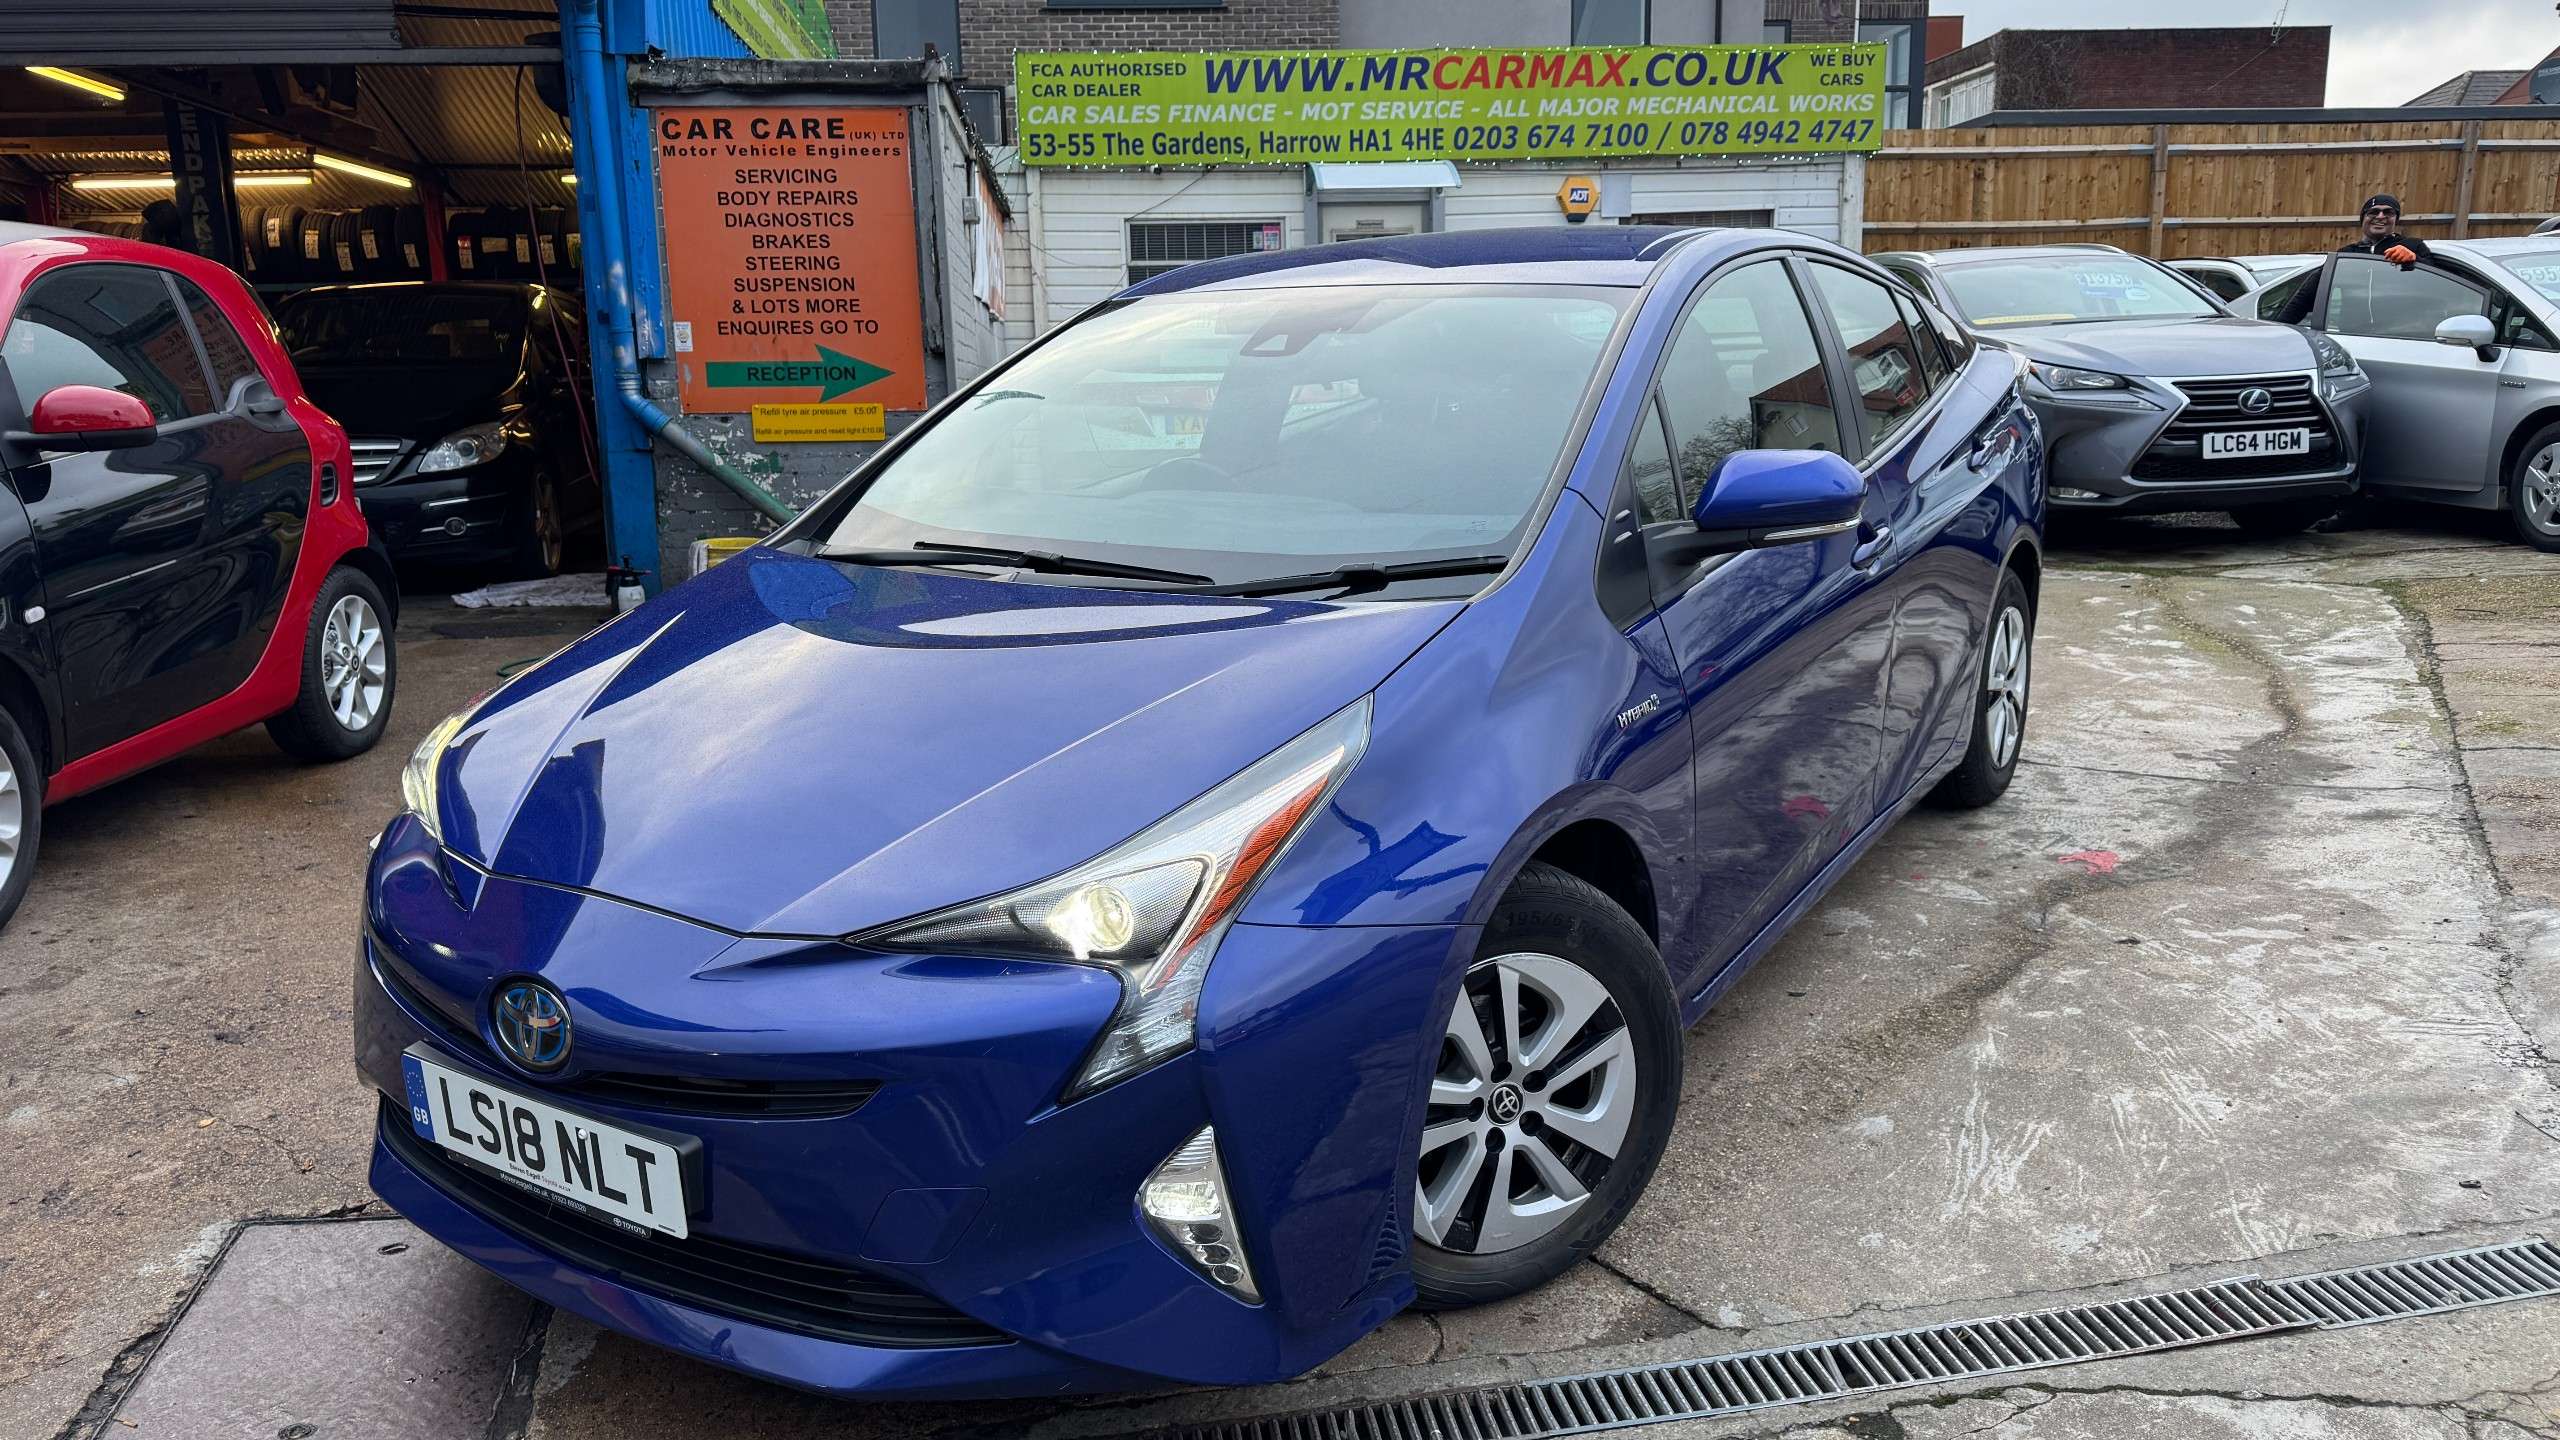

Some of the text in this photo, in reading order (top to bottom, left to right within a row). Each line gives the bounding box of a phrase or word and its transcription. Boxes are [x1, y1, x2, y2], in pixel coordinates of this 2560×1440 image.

[1810, 53, 1876, 67] WE BUY
[1031, 62, 1187, 77] FCA AUTHORISED
[1204, 51, 1790, 94] WWW.MRCARMAX.CO.UK
[1820, 73, 1864, 86] CARS
[1031, 83, 1142, 98] CAR DEALER
[1027, 105, 1077, 124] CAR
[1084, 104, 1161, 124] SALES
[1168, 103, 1277, 124] FINANCE
[1301, 101, 1355, 121] MOT
[1360, 100, 1465, 121] SERVICE
[1487, 99, 1530, 119] ALL
[1537, 97, 1620, 118] MAJOR
[1626, 95, 1780, 116] MECHANICAL
[1789, 93, 1875, 113] WORKS
[661, 117, 905, 142] CAR CARE (UK) LTD
[1029, 119, 1874, 159] 53-55 The Gardens, Harrow HA1 4HE 0203 674 7100 / 078 4942 4747
[662, 143, 902, 159] Motor Vehicle Engineers
[735, 168, 838, 184] SERVICING
[718, 190, 858, 206] BODY REPAIRS
[1570, 189, 1589, 202] ADT
[725, 212, 855, 228] DIAGNOSTICS
[752, 234, 831, 249] BRAKES
[745, 255, 840, 271] STEERING
[734, 277, 856, 293] SUSPENSION
[732, 298, 861, 314] & LOTS MORE
[717, 319, 879, 336] ENQUIRES GO TO
[747, 366, 857, 382] RECEPTION
[760, 405, 878, 419] Refill tyre air pressure £5.00
[814, 427, 827, 435] and
[2211, 431, 2302, 454] LC64 HGM
[1617, 699, 1654, 728] HYBRID
[413, 1105, 430, 1126] GB
[439, 1076, 656, 1215] LS18 NLT
[621, 1220, 647, 1237] TOYOTA
